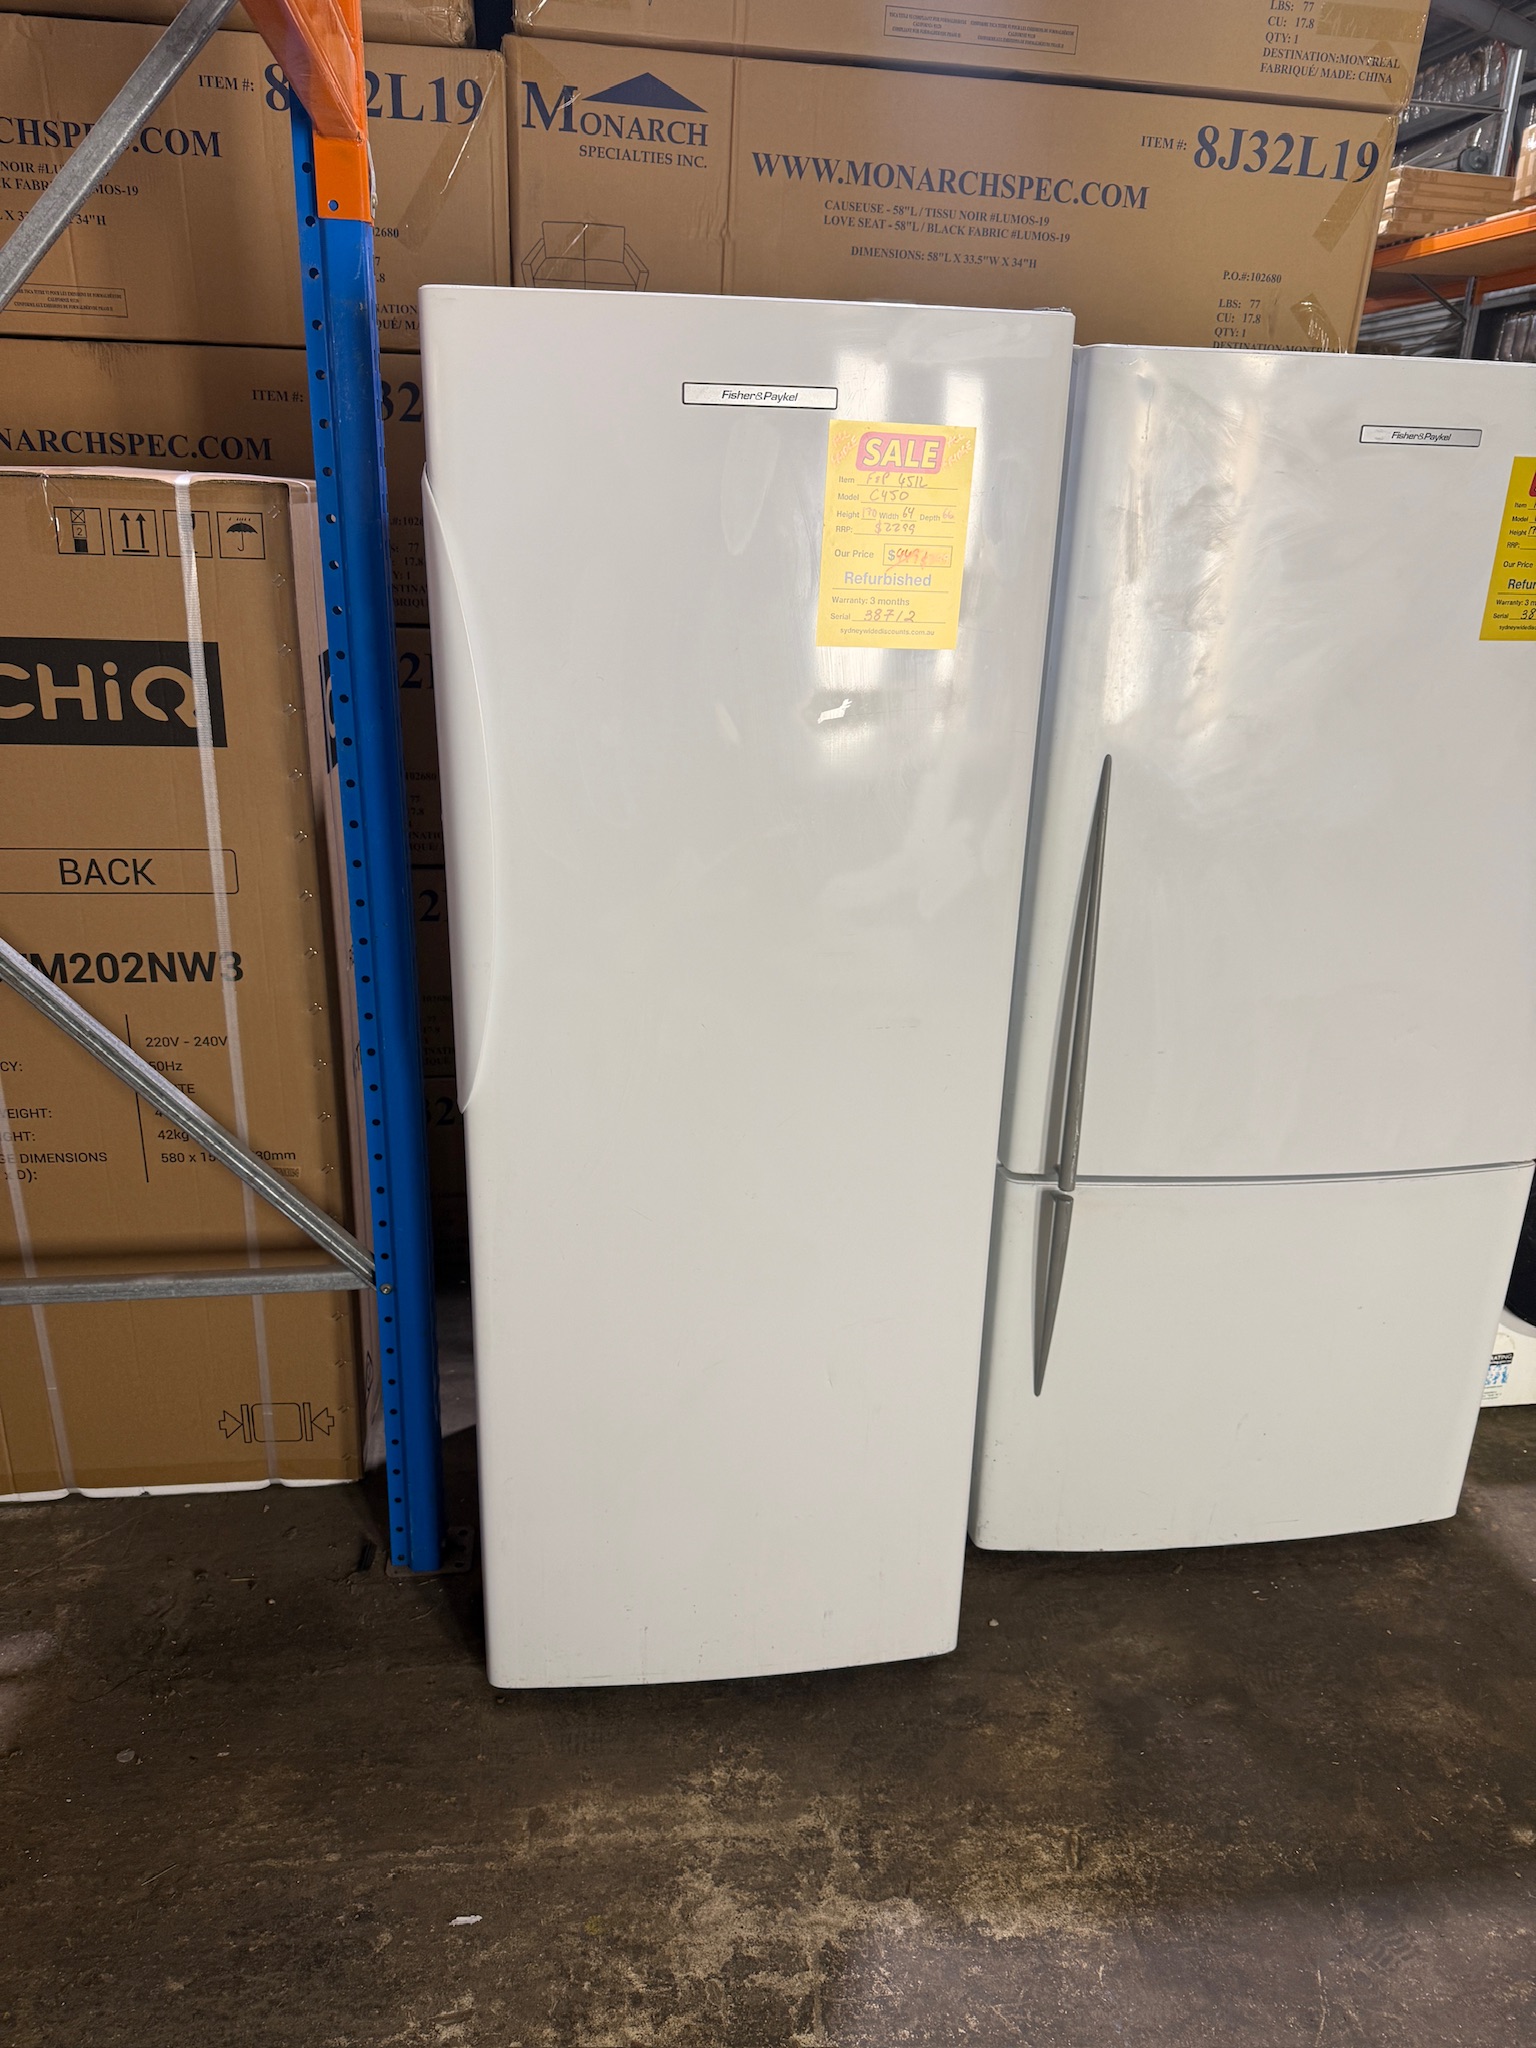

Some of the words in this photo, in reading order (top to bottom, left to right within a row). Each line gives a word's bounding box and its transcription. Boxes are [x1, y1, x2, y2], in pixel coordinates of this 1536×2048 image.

[1270, 0, 1294, 11] LBS:
[1303, 2, 1314, 12] 77
[1267, 16, 1287, 27] CU:
[1296, 17, 1315, 28] 17.8
[1265, 31, 1291, 44] QTY:
[1294, 35, 1298, 44] 1
[1263, 47, 1400, 69] DESTINATION:MONTREAL
[1260, 62, 1318, 77] FABRIQUÉ/
[1320, 68, 1356, 80] MADE:
[1358, 71, 1392, 84] CHINA
[198, 74, 239, 91] ITEM
[242, 78, 254, 91] #:
[579, 144, 673, 165] SPECIALTIES
[677, 154, 707, 169] INC.
[1141, 135, 1174, 149] ITEM
[1176, 139, 1187, 150] #:
[1193, 125, 1380, 183] 8J32L19
[751, 152, 1150, 210] WWW.MONARCHSPEC.COM
[824, 199, 884, 213] CAUSEUSE
[893, 205, 917, 217] 58"L
[925, 207, 957, 219] TISSU
[959, 210, 987, 221] NOIR
[990, 213, 1050, 226] #LUMOS-19
[823, 214, 855, 227] LOVE
[857, 218, 886, 229] SEAT
[894, 220, 919, 232] 58"L
[927, 223, 966, 236] BLACK
[968, 226, 1009, 239] FABRIC
[1011, 229, 1070, 242] #LUMOS-19
[851, 246, 925, 260] DIMENSIONS:
[927, 251, 951, 263] 58"L
[953, 253, 961, 263] X
[963, 254, 1000, 265] 33.5"W
[1001, 257, 1009, 267] X
[1011, 258, 1037, 268] 34"H
[1223, 270, 1282, 284] P.O.#:102680
[1219, 298, 1241, 309] LBS:
[1250, 299, 1261, 309] 77
[1216, 312, 1235, 323] CU:
[1243, 313, 1261, 324] 17.8
[1214, 327, 1239, 338] QTY:
[1242, 329, 1246, 338] 1
[252, 389, 289, 401] ITEM
[292, 392, 304, 402] #:
[721, 390, 799, 403] Fisher&Paykel
[1391, 431, 1452, 442] Fisher&Paykel
[862, 437, 939, 470] SALE
[838, 475, 855, 484] Item
[838, 492, 860, 501] Model
[836, 510, 860, 519] Height
[879, 512, 899, 520] Width
[920, 513, 941, 522] Depth
[835, 525, 853, 533] RRP:
[834, 548, 850, 558] Our
[852, 549, 874, 559] Price
[1503, 560, 1516, 568] Our
[844, 571, 932, 587] Refurbished
[831, 596, 868, 605] Warranty:
[870, 596, 876, 605] 3
[878, 597, 910, 606] months
[830, 612, 851, 620] Serial
[840, 627, 935, 636] sydneywidediscounts.com.au
[58, 857, 156, 886] BACK
[145, 1036, 180, 1048] 220V
[194, 1036, 228, 1047] 240V
[157, 1129, 189, 1142] 42kg
[20, 1152, 108, 1164] DIMENSIONS
[161, 1152, 185, 1163] 580
[189, 1155, 197, 1163] x
